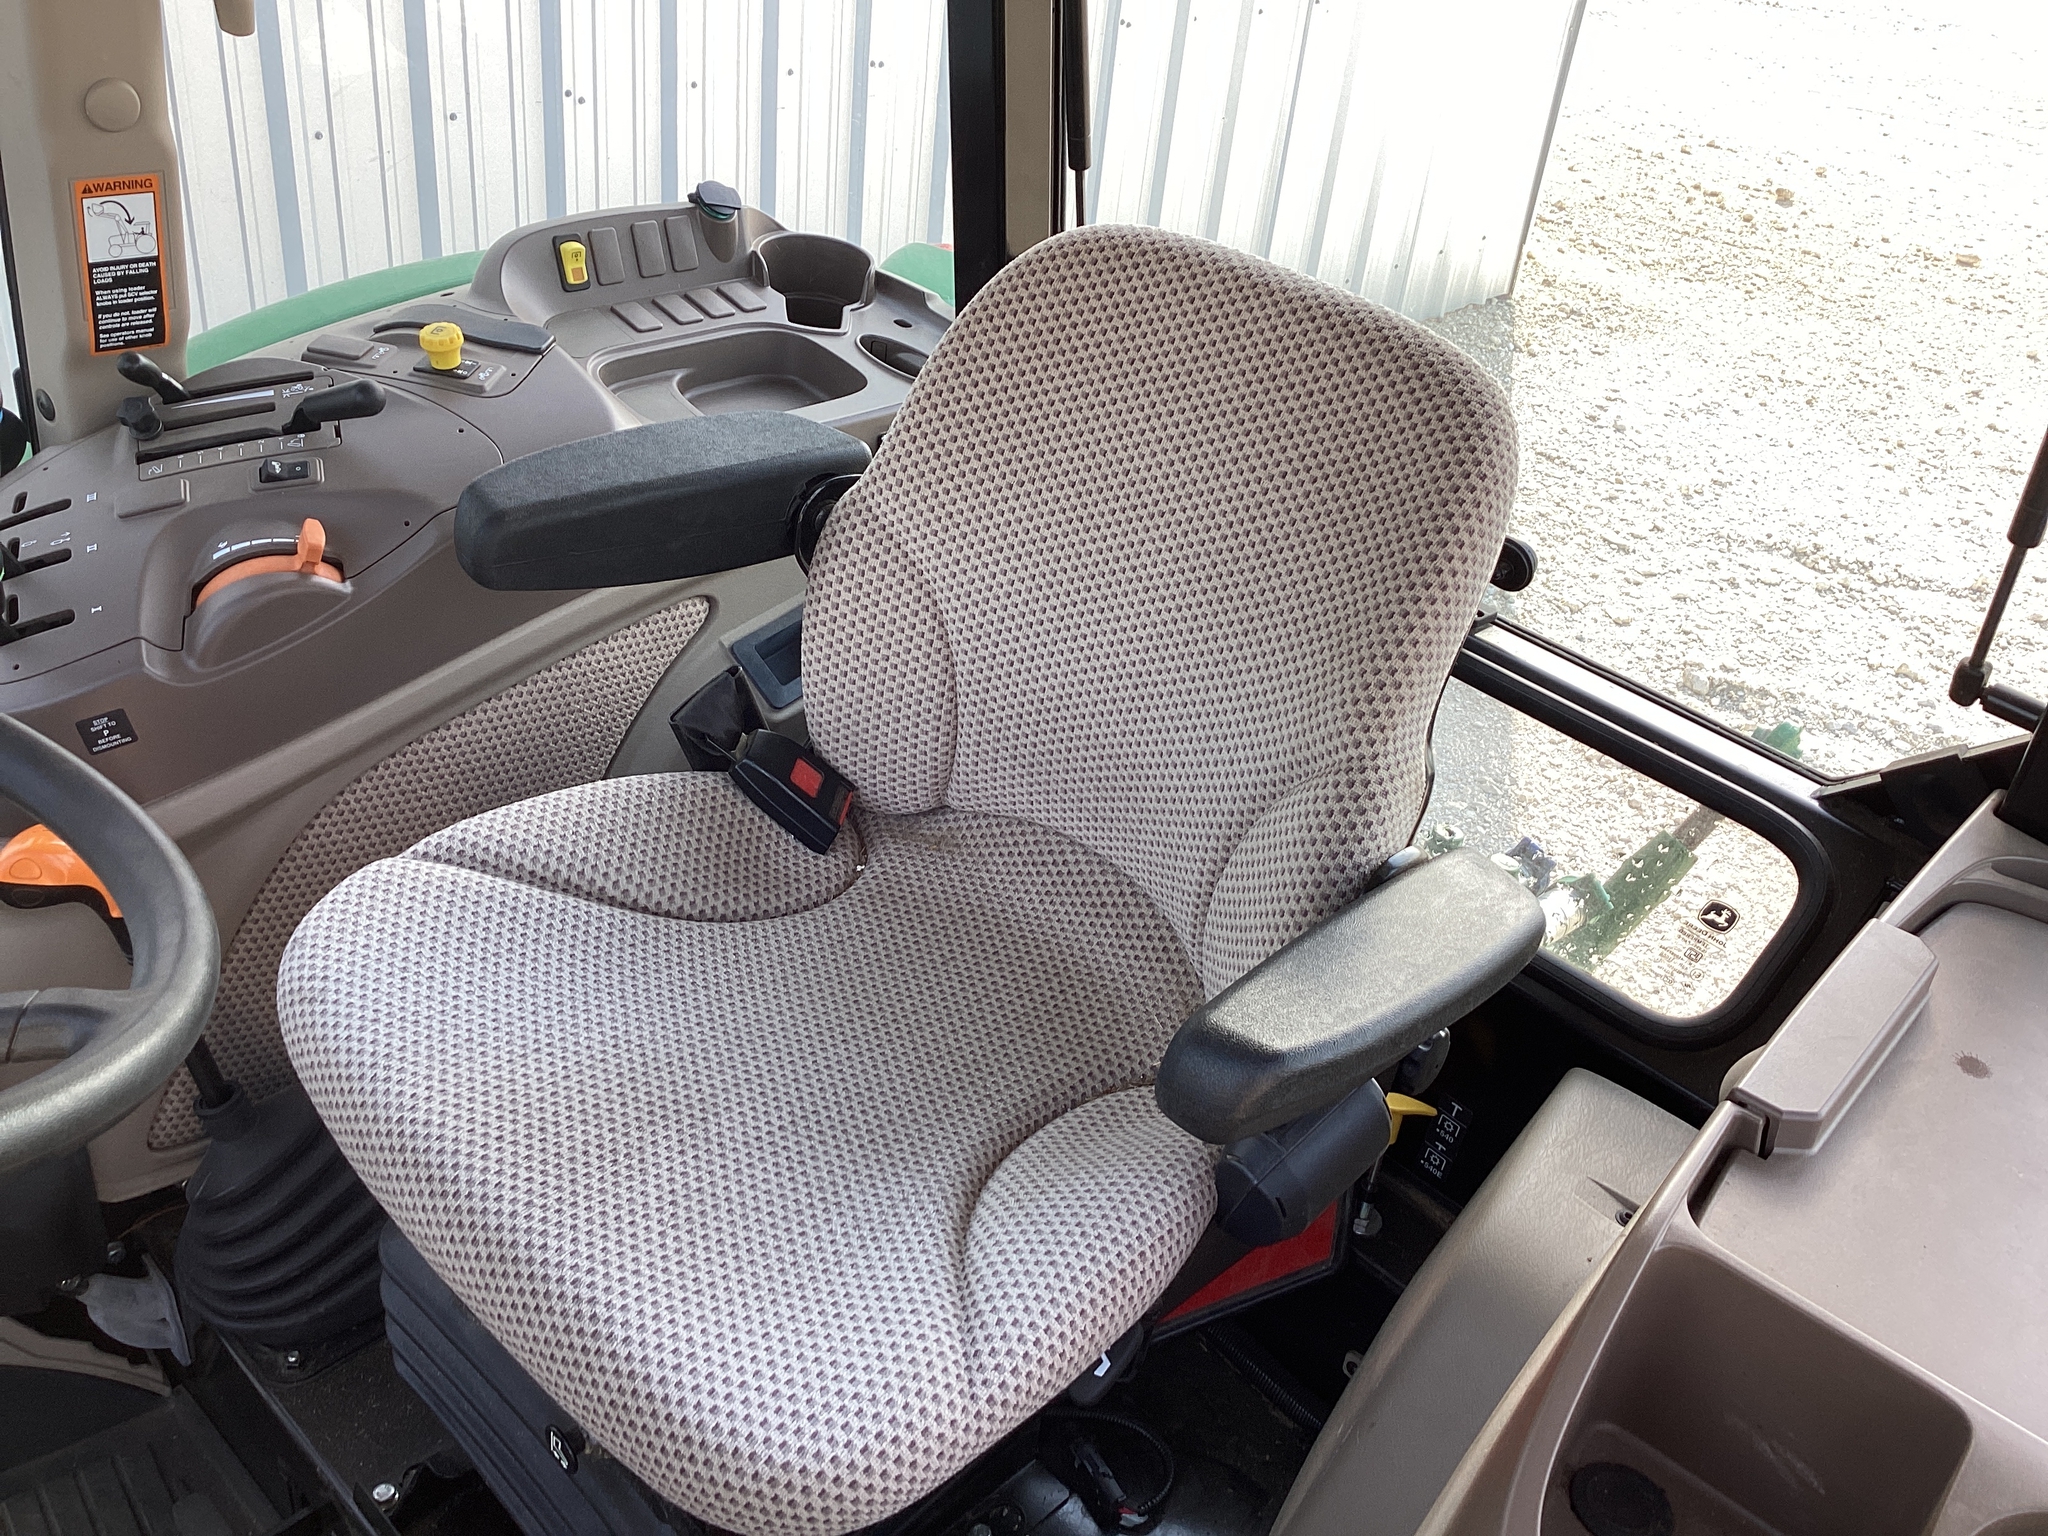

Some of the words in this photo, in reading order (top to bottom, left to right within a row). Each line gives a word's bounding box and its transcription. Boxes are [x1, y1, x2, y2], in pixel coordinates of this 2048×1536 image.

[92, 178, 153, 192] WARNING
[93, 737, 132, 752] DISMOUNTING
[98, 734, 121, 744] BEFORE
